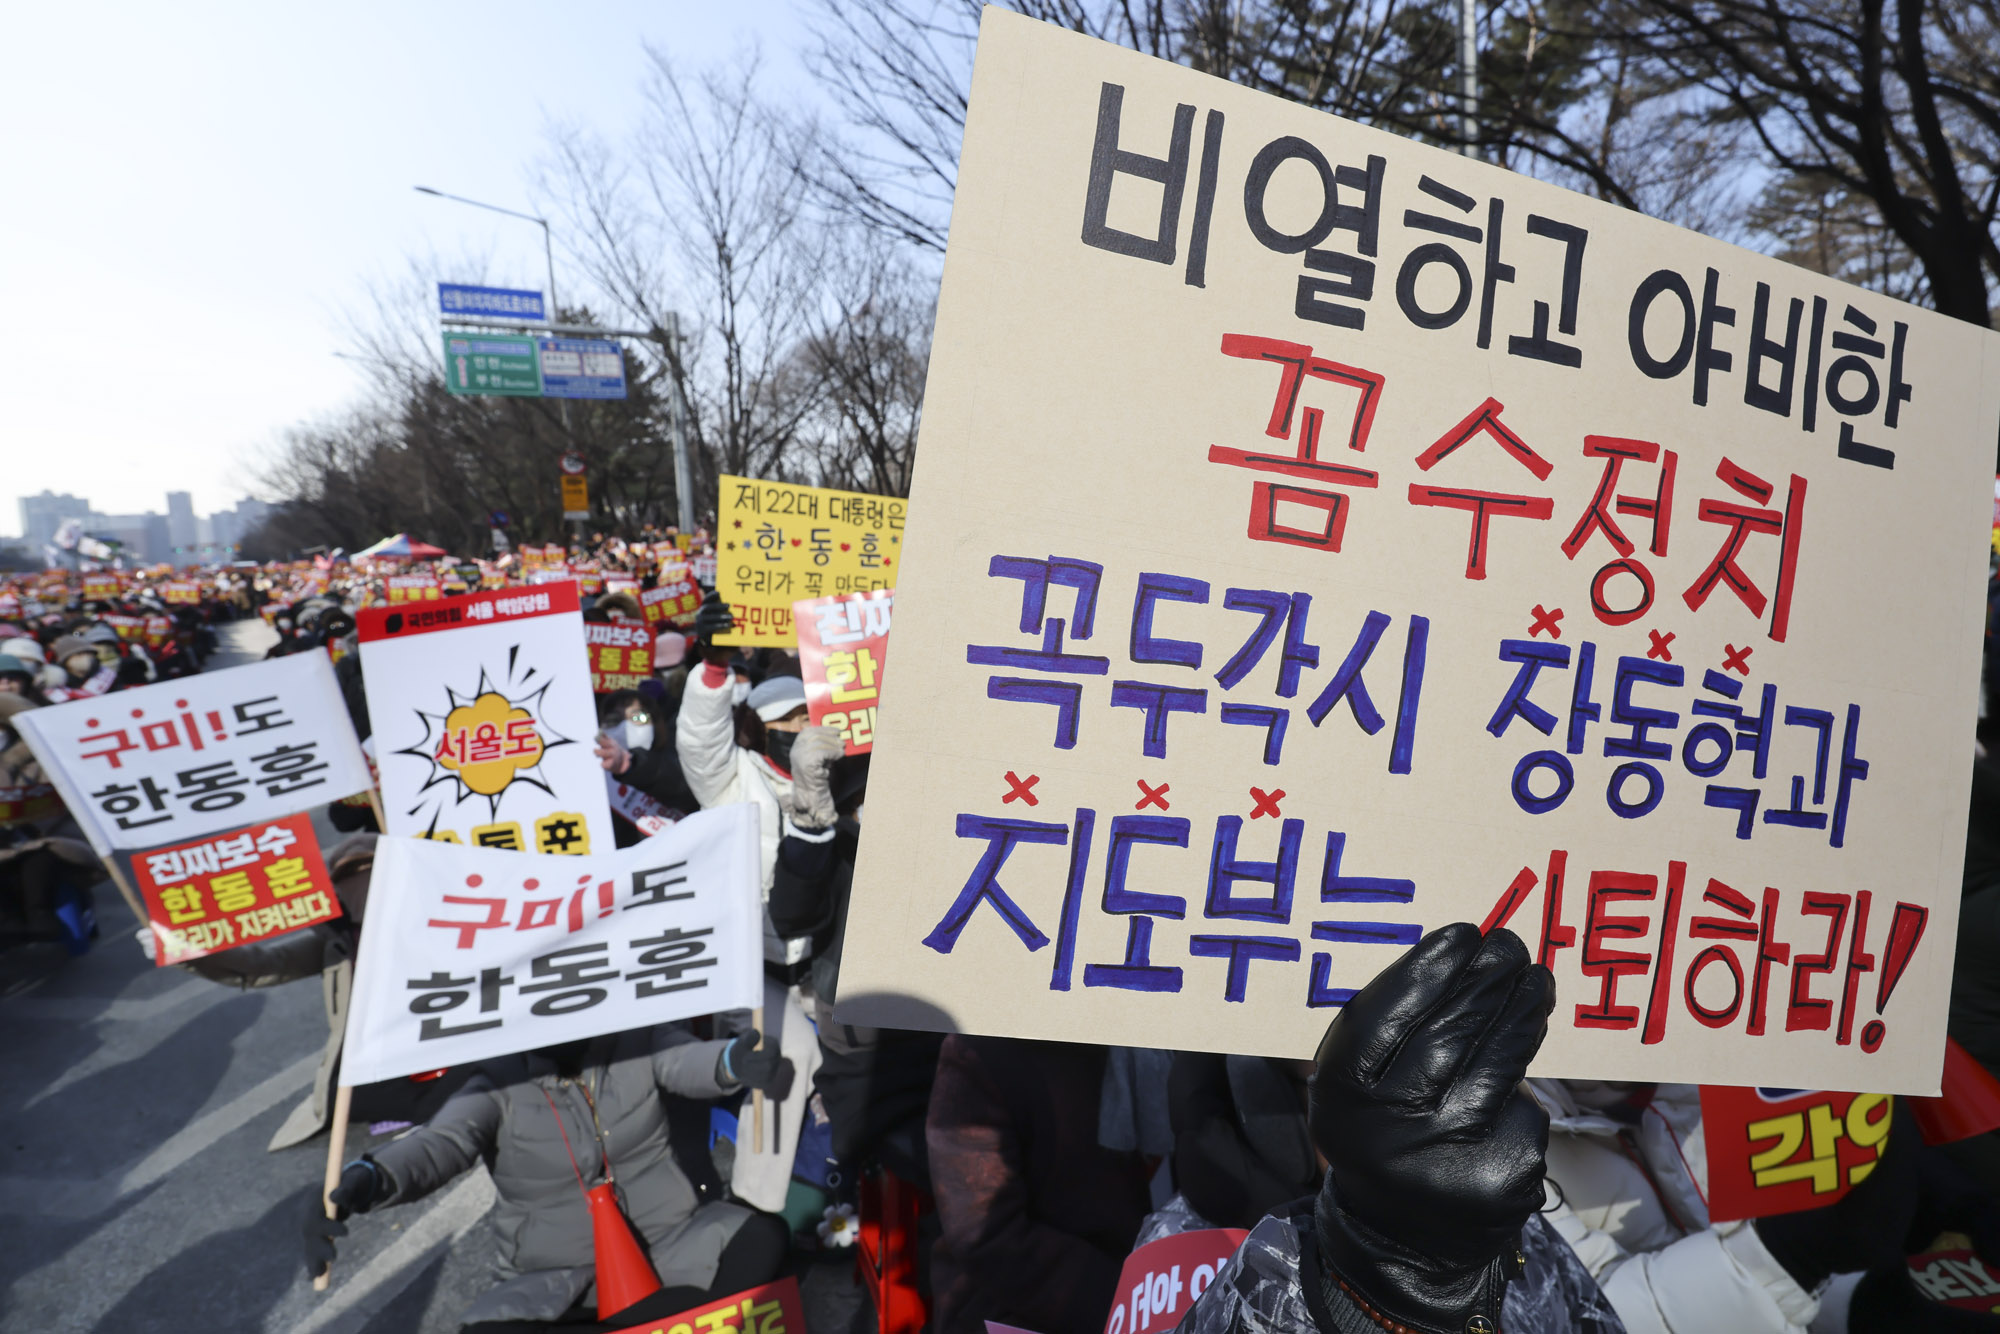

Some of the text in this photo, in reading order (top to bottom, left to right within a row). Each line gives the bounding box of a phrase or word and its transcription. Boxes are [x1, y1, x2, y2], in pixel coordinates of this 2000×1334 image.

[1081, 82, 1912, 470] 비열하고 야비한
[733, 484, 906, 531] 제22대 대통령은
[466, 602, 495, 621] 서울
[496, 593, 551, 615] 책임당원
[736, 565, 794, 595] 우리가
[585, 624, 650, 647] 짜보수
[966, 554, 1869, 849] 꼭두각시 장동혁과
[432, 718, 541, 767] 서울도
[91, 741, 330, 831] 한동훈
[146, 824, 297, 886] 진짜보수
[240, 891, 332, 938] 지켜낸다
[922, 807, 1425, 1009] 지도부는
[407, 927, 718, 1042] 한동훈
